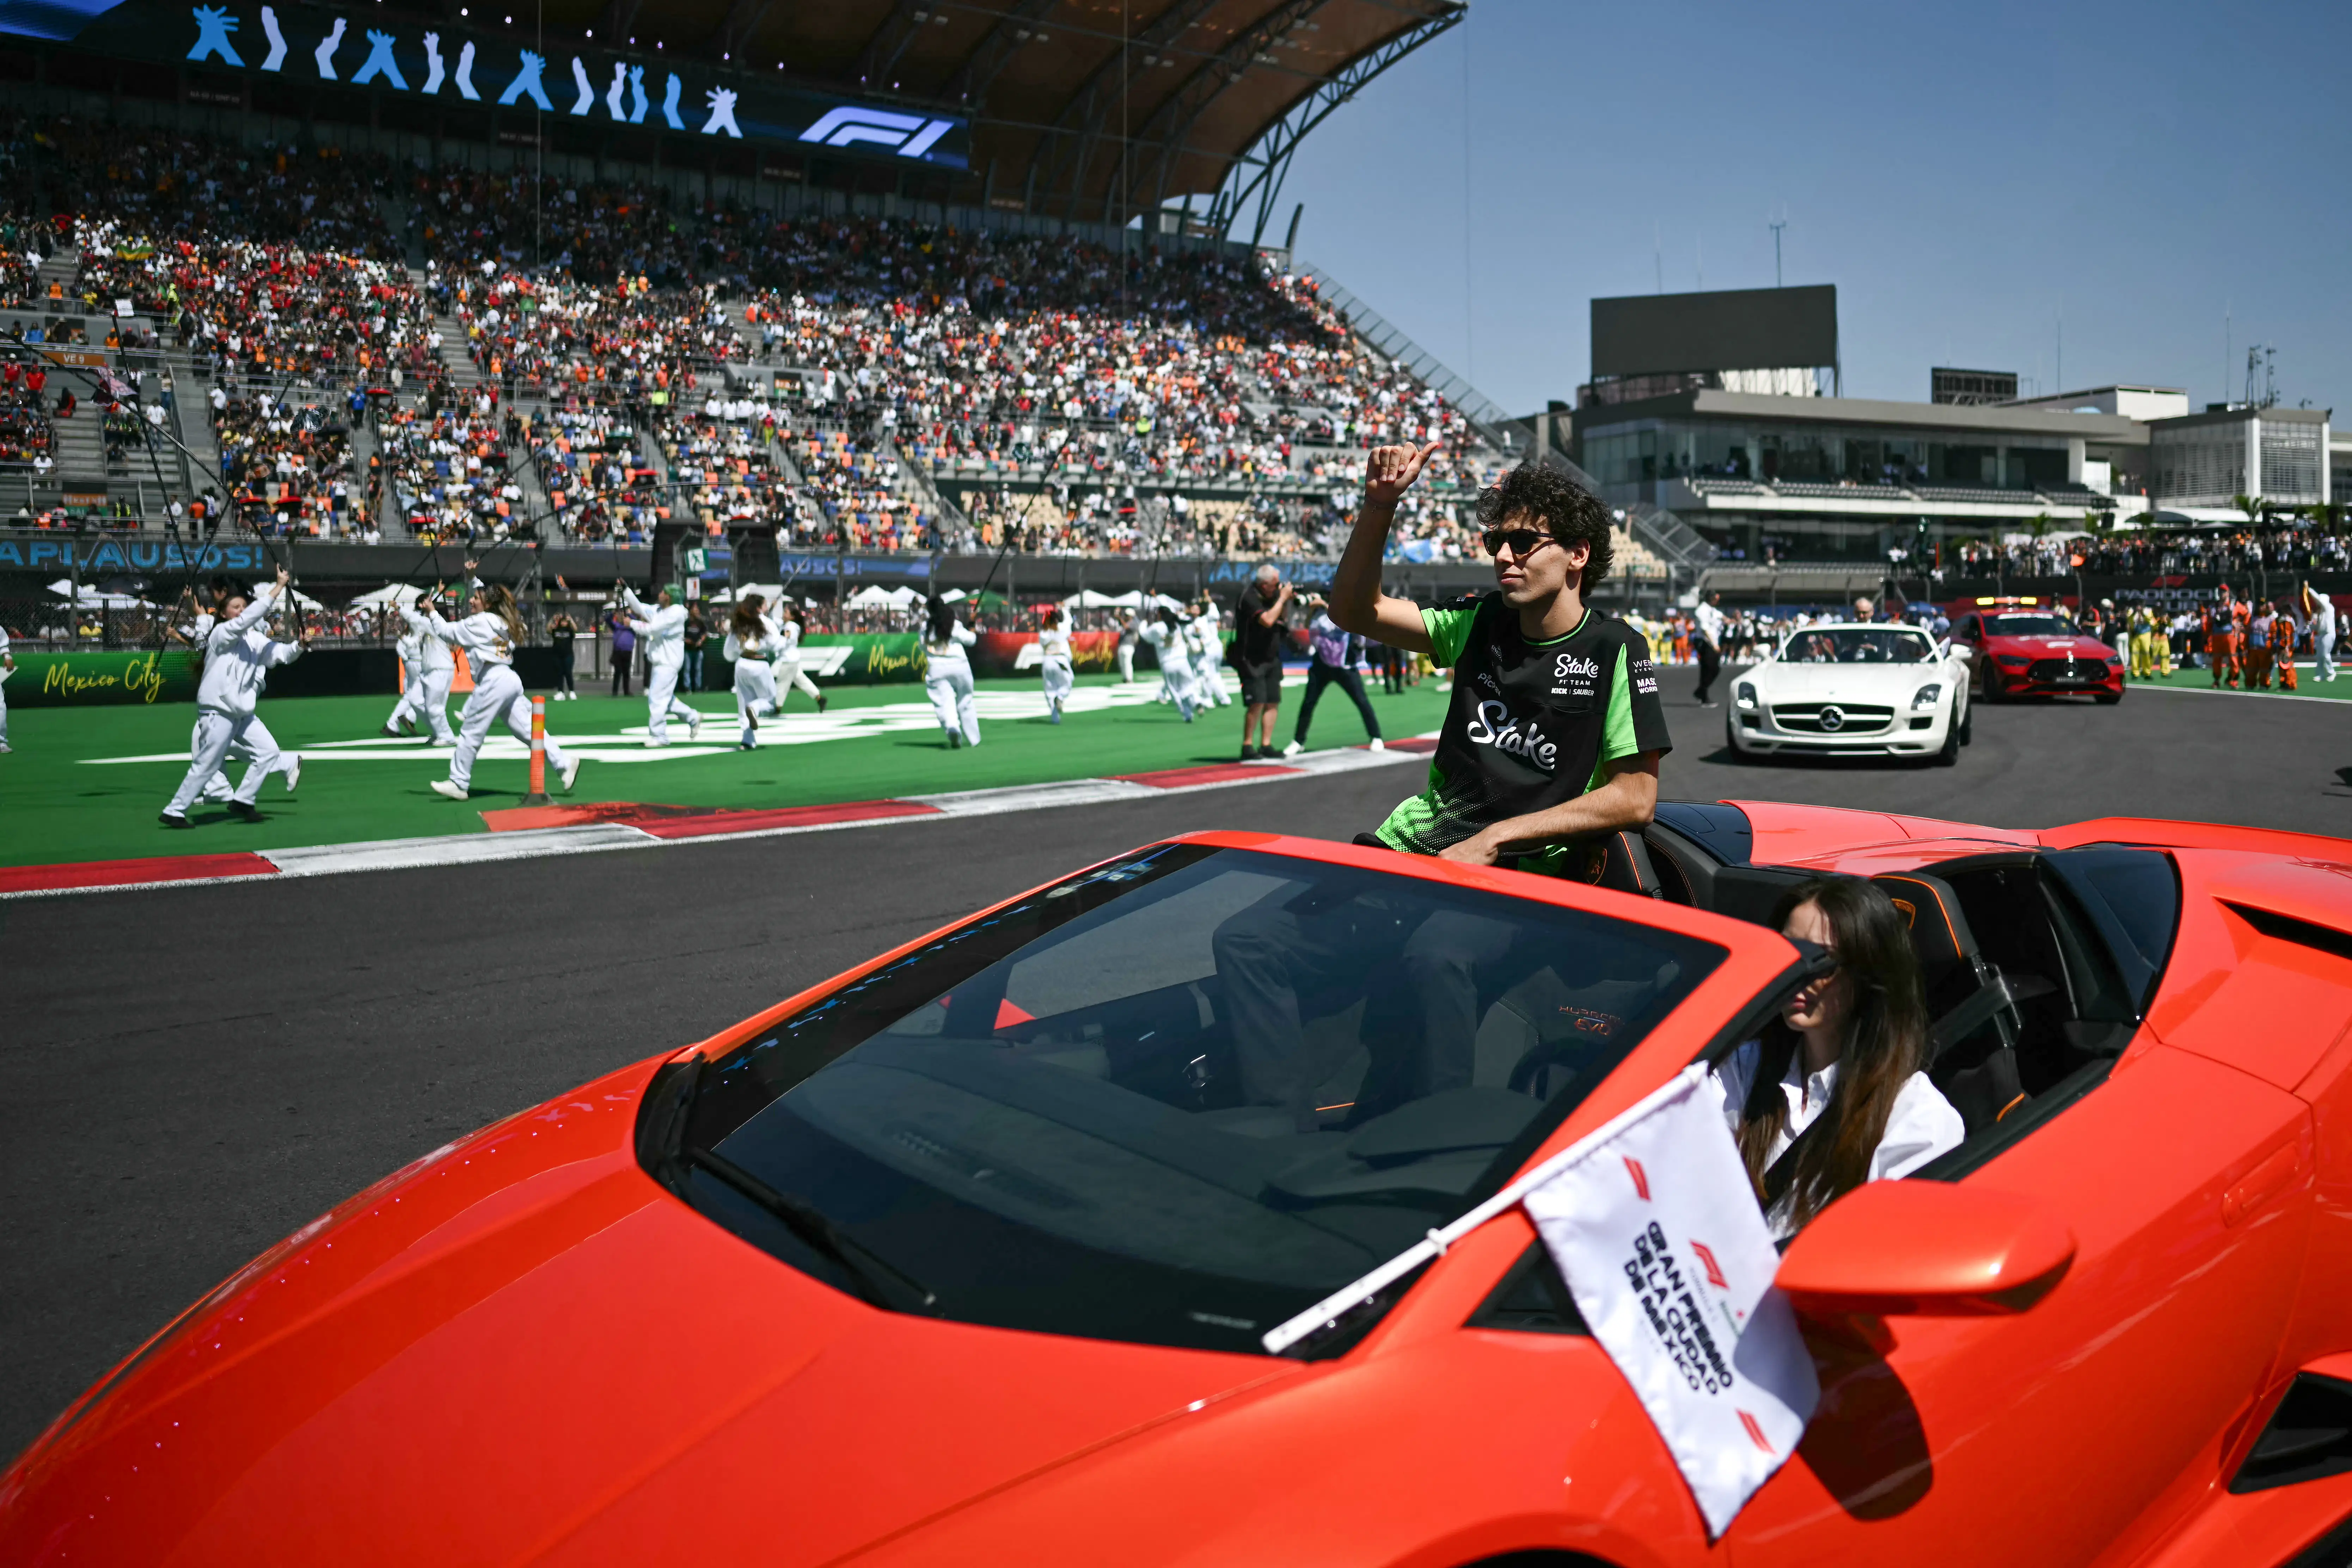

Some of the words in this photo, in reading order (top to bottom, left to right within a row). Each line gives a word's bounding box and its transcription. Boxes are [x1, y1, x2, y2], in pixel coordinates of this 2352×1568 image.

[63, 353, 76, 363] VE
[79, 354, 84, 364] 9
[2115, 588, 2213, 600] PADDOC
[868, 643, 909, 677] Mexico
[1554, 654, 1599, 678] Stake
[1633, 660, 1653, 668] WEB
[44, 662, 120, 697] Mexico
[125, 651, 167, 704] City
[1467, 700, 1557, 770] Stake
[1574, 1018, 1611, 1035] EVO
[1624, 1259, 1646, 1293] DE
[1634, 1235, 1654, 1268] DE
[1647, 1268, 1668, 1304] LA
[1667, 1307, 1718, 1395] CIUDAD
[1648, 1221, 1685, 1291] GRAN
[1678, 1292, 1732, 1388] PREMIO
